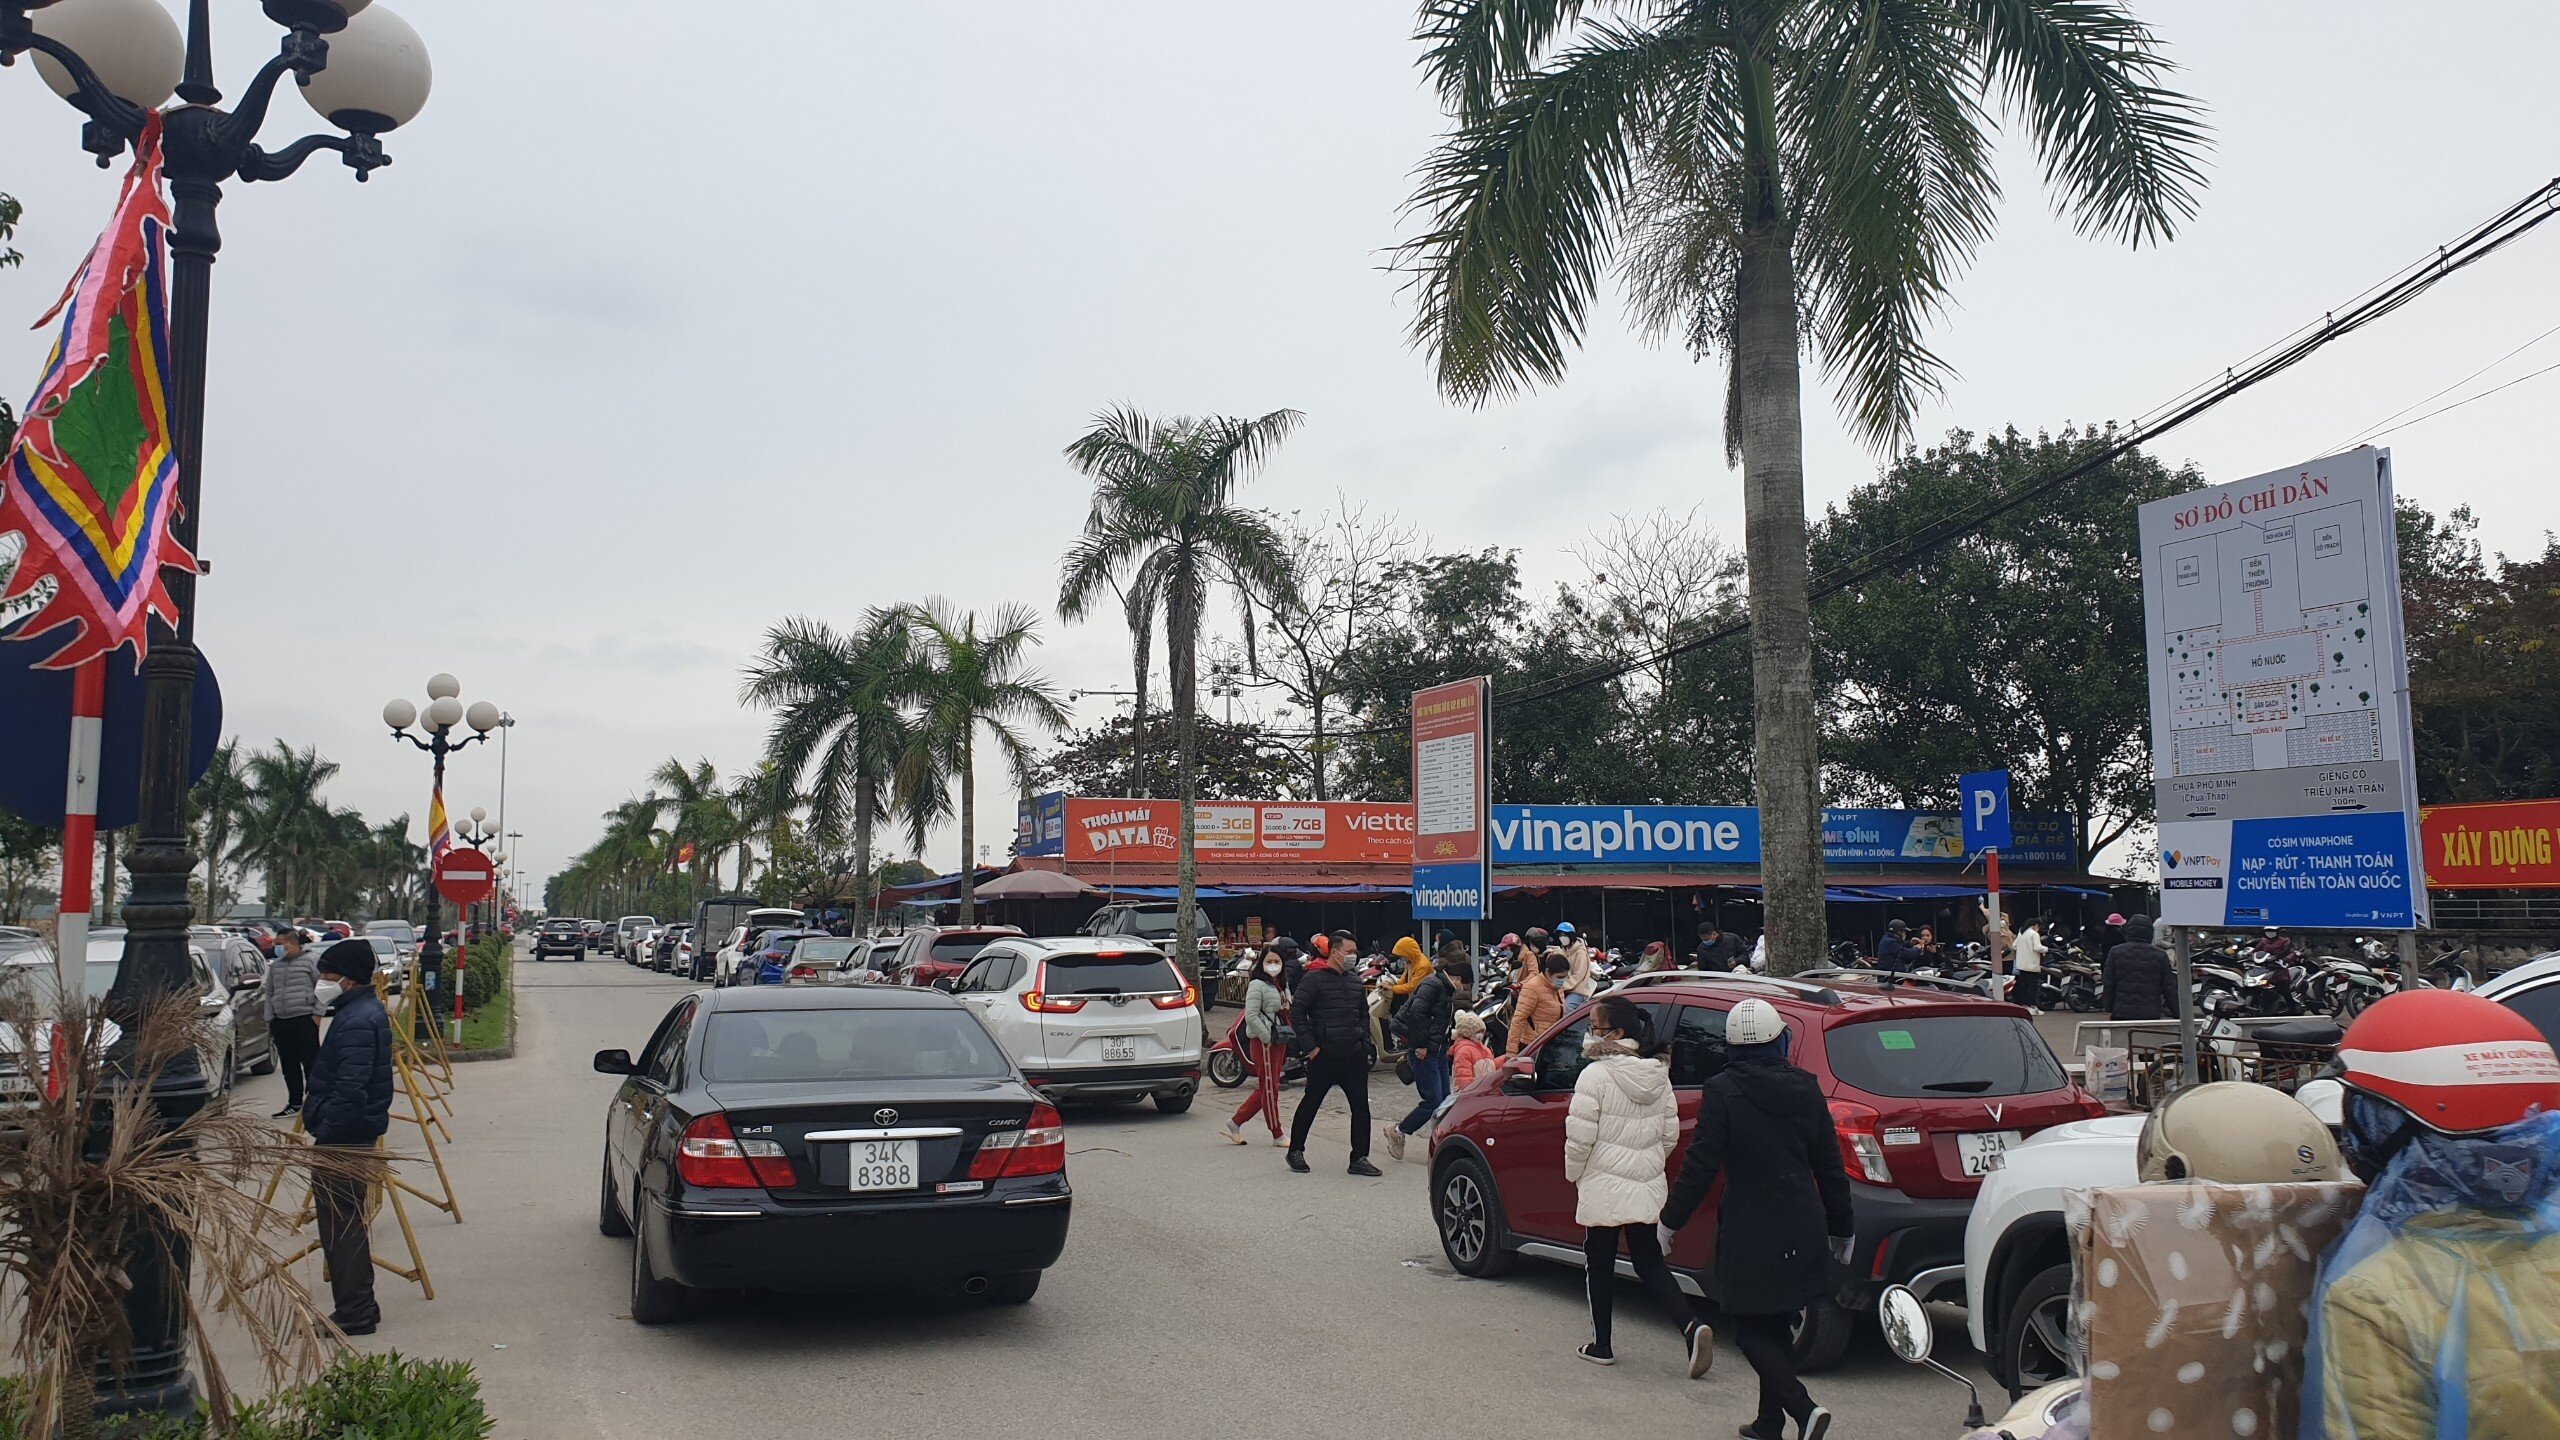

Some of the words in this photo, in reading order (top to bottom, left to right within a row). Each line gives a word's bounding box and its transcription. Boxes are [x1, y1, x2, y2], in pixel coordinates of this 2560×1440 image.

[2174, 506, 2199, 530] SƠ
[2204, 492, 2233, 523] ĐỒ
[2238, 483, 2277, 515] CHỈ
[2282, 472, 2329, 505] DẪN
[2332, 797, 2357, 806] 300m
[1125, 806, 1151, 823] MÁI
[1974, 789, 1996, 832] P
[1221, 817, 1253, 830] 3GB
[1292, 818, 1322, 831] 7GB
[1345, 811, 1413, 832] viette
[2013, 818, 2032, 831] ỐC
[1088, 825, 1151, 853] DATA
[1491, 808, 1740, 858] vinaphone
[1822, 830, 1844, 844] ME
[2015, 833, 2040, 846] GIÁ
[1154, 834, 1175, 848] 15K
[2283, 836, 2298, 848] SIM
[2299, 834, 2353, 847] VINAPHONE
[2442, 824, 2482, 867] XÂY
[2489, 825, 2552, 873] DỰNG
[1876, 848, 1896, 859] ĐỘNG
[2024, 851, 2067, 860] 18001166
[2275, 853, 2298, 871] RÚT
[2308, 854, 2351, 869] THANH
[2355, 851, 2394, 868] TOÁN
[2170, 879, 2193, 888] MOBILE
[2194, 879, 2217, 887] MONEY
[2318, 872, 2356, 889] TOÀN
[2358, 870, 2402, 889] QUỐC
[1415, 884, 1479, 911] vinaphone
[2463, 1052, 2479, 1061] XE
[2481, 1049, 2505, 1060] MÁY
[0, 1079, 16, 1090] 8A
[1977, 1133, 2007, 1153] 35A
[865, 1142, 904, 1163] 34K
[858, 1165, 911, 1187] 8388
